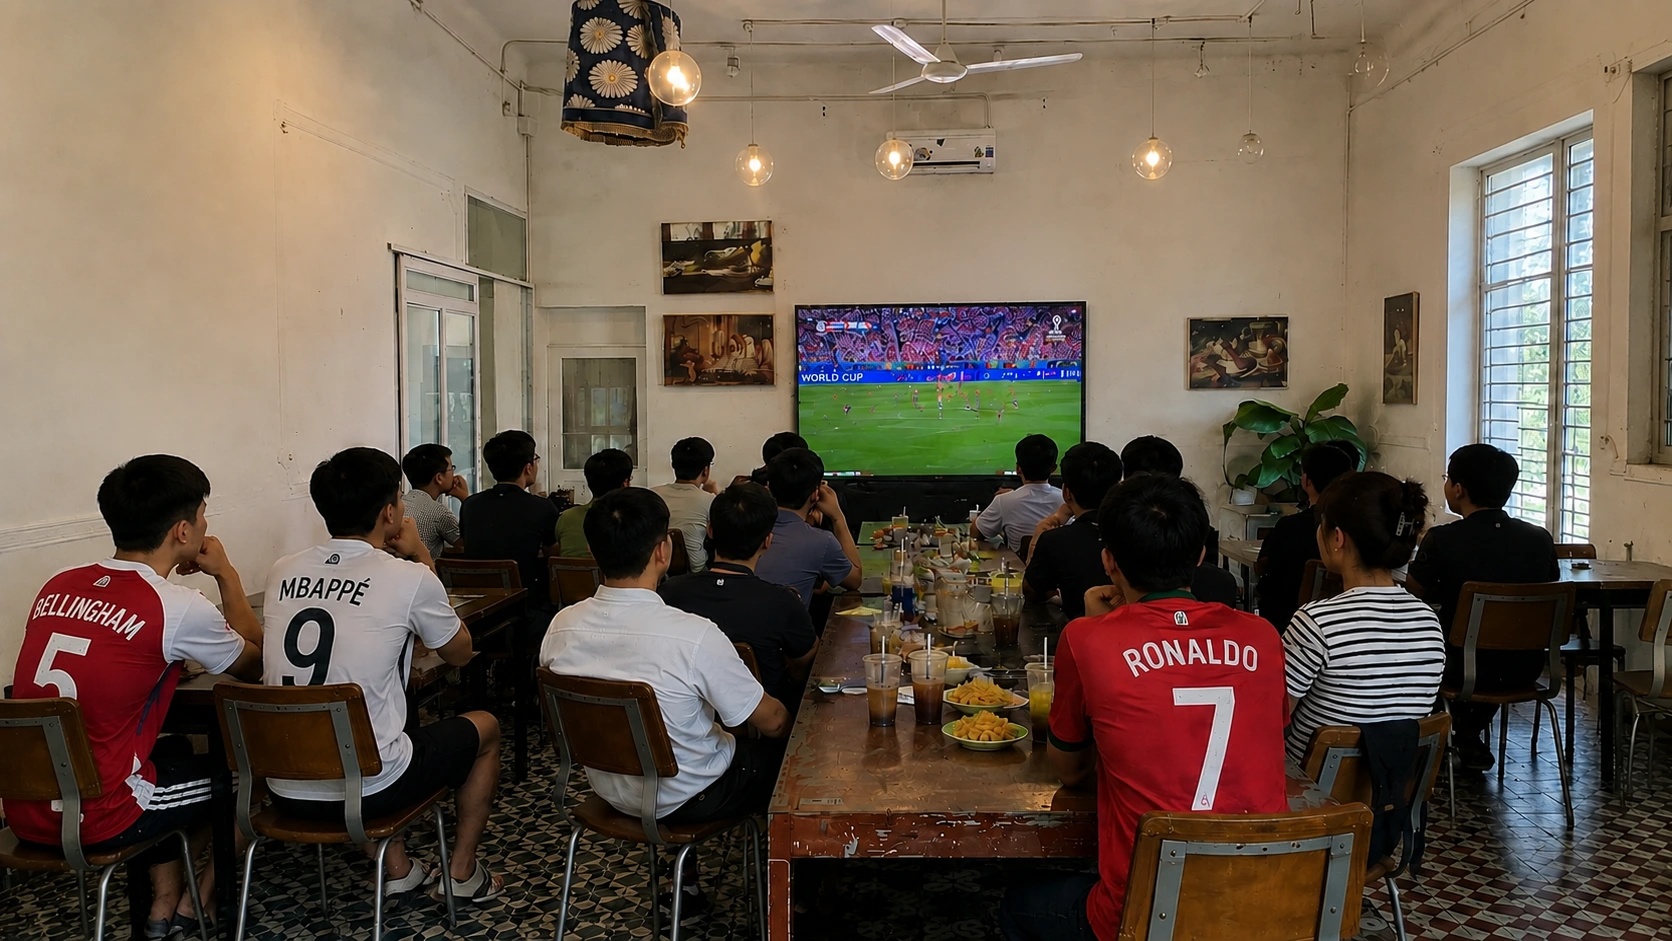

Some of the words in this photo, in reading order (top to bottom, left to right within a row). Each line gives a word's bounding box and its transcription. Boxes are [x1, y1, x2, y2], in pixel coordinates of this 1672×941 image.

[801, 373, 839, 383] WORLD
[842, 372, 863, 382] CUP
[278, 576, 371, 606] MBAPPÉ
[32, 592, 146, 641] BELLINGHAM
[32, 631, 92, 700] 5
[282, 606, 336, 686] 9
[1122, 638, 1259, 678] RONALDO
[1172, 686, 1236, 811] 7
